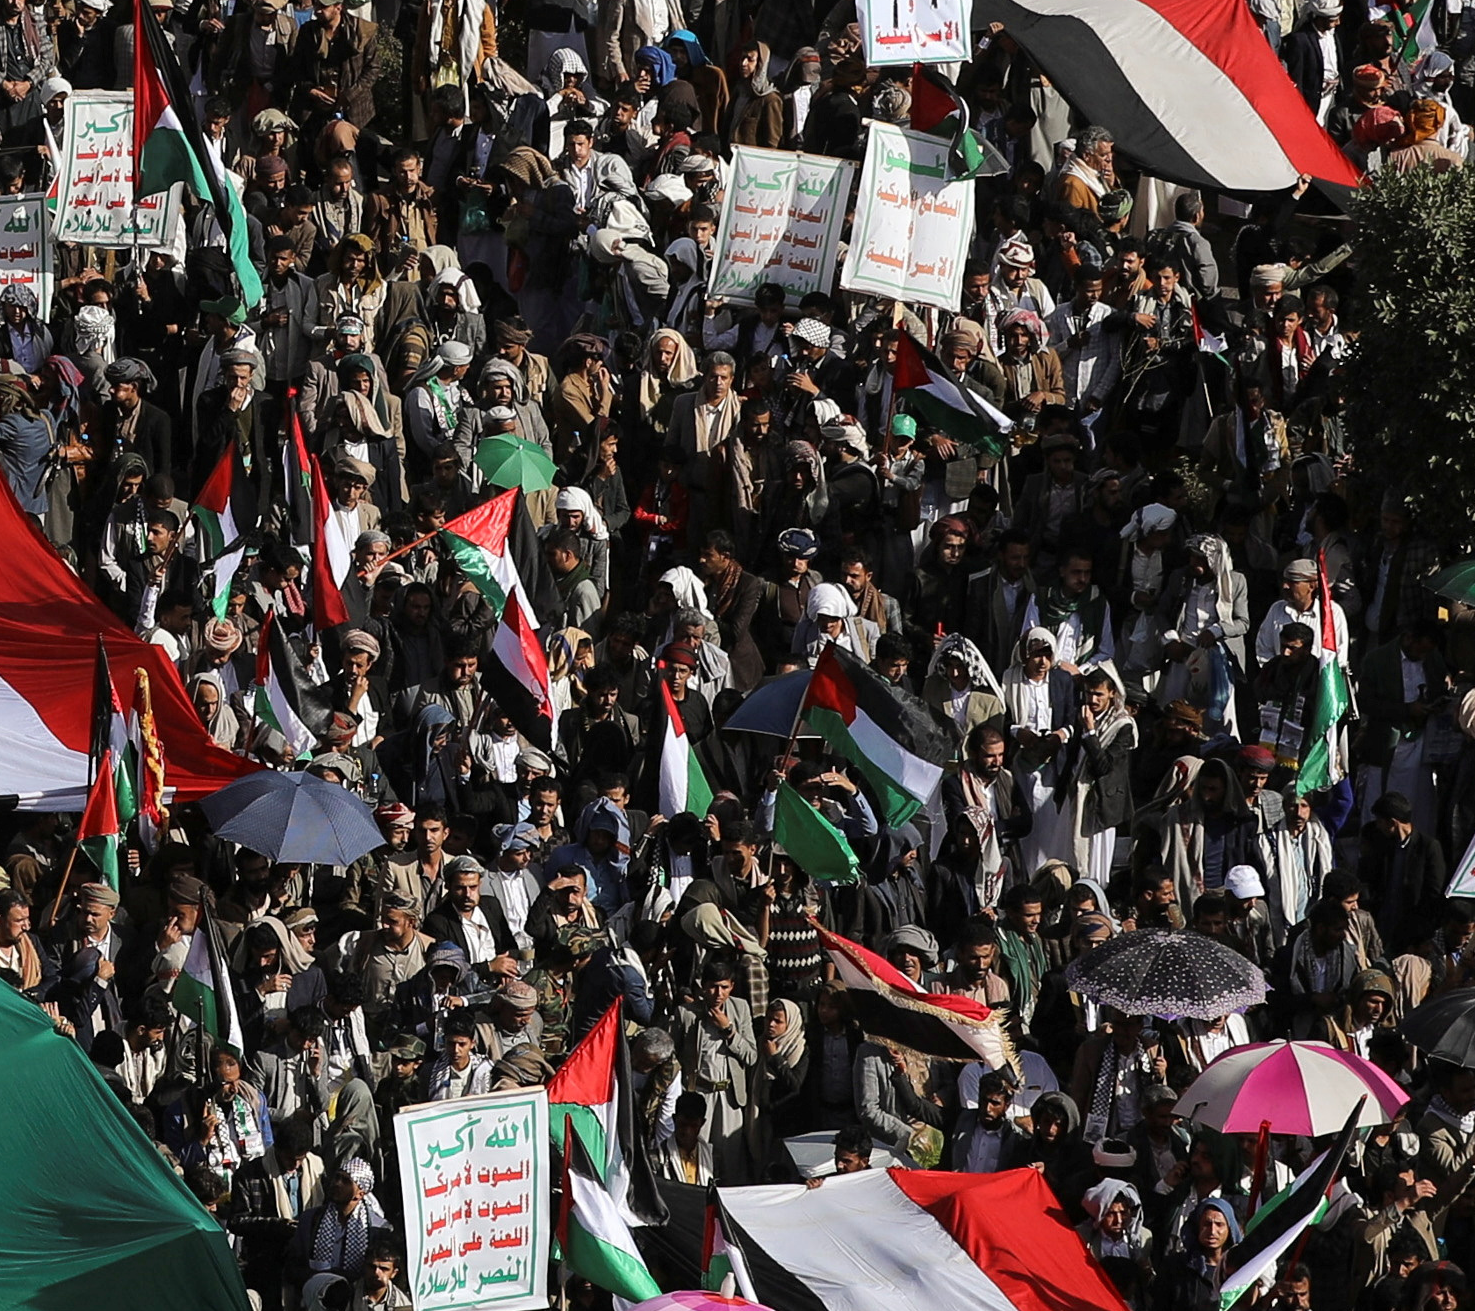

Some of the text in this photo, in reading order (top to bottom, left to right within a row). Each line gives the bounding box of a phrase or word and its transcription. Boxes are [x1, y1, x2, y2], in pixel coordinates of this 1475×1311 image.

[874, 20, 959, 49] الإسرائيلية
[421, 1115, 530, 1169] الله أكبر
[478, 1160, 530, 1183] الموت
[478, 1193, 530, 1219] الموت
[423, 1227, 530, 1267] اللعنة على اليهود
[477, 1256, 527, 1295] النصر
